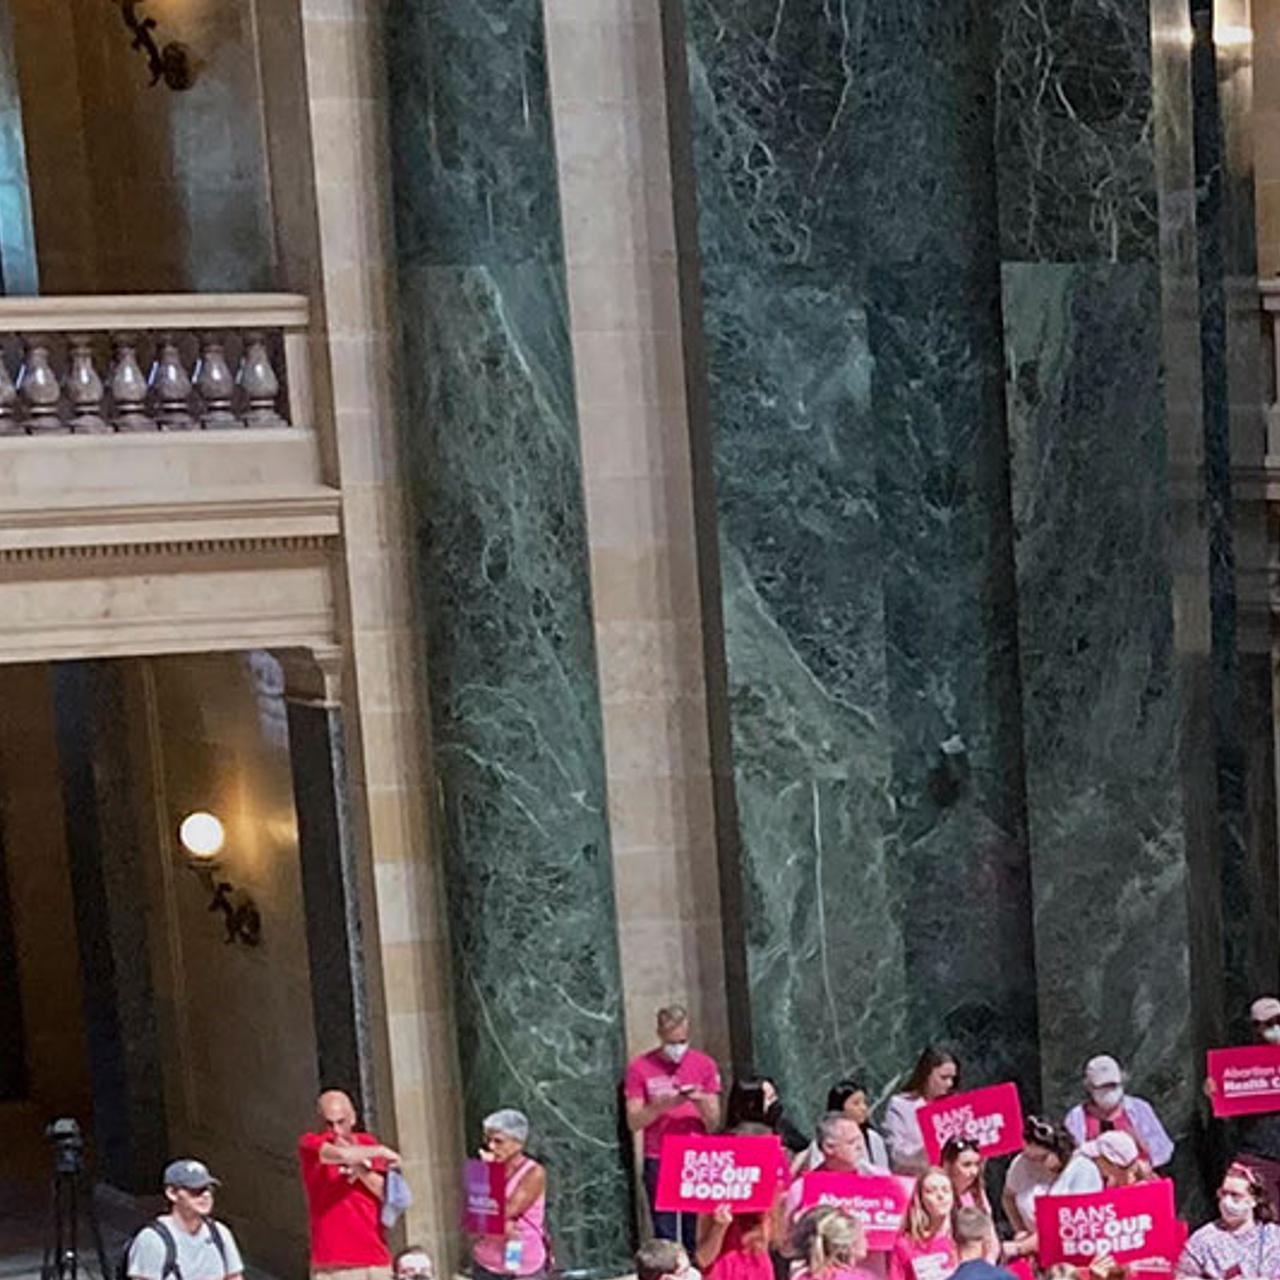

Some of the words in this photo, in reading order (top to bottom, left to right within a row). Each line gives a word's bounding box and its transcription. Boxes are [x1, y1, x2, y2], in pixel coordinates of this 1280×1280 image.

[1223, 1065, 1275, 1080] Abortion
[1223, 1077, 1270, 1091] Health
[932, 1105, 975, 1126] BANS
[964, 1112, 1005, 1136] OUR
[683, 1149, 736, 1168] BANS
[681, 1166, 722, 1184] OFF
[721, 1165, 762, 1185] OUR
[680, 1182, 753, 1201] BODIES
[1059, 1203, 1116, 1224] BANS
[1059, 1220, 1104, 1241] OFF
[1103, 1214, 1152, 1237] OUR
[1062, 1231, 1146, 1256] BODIES
